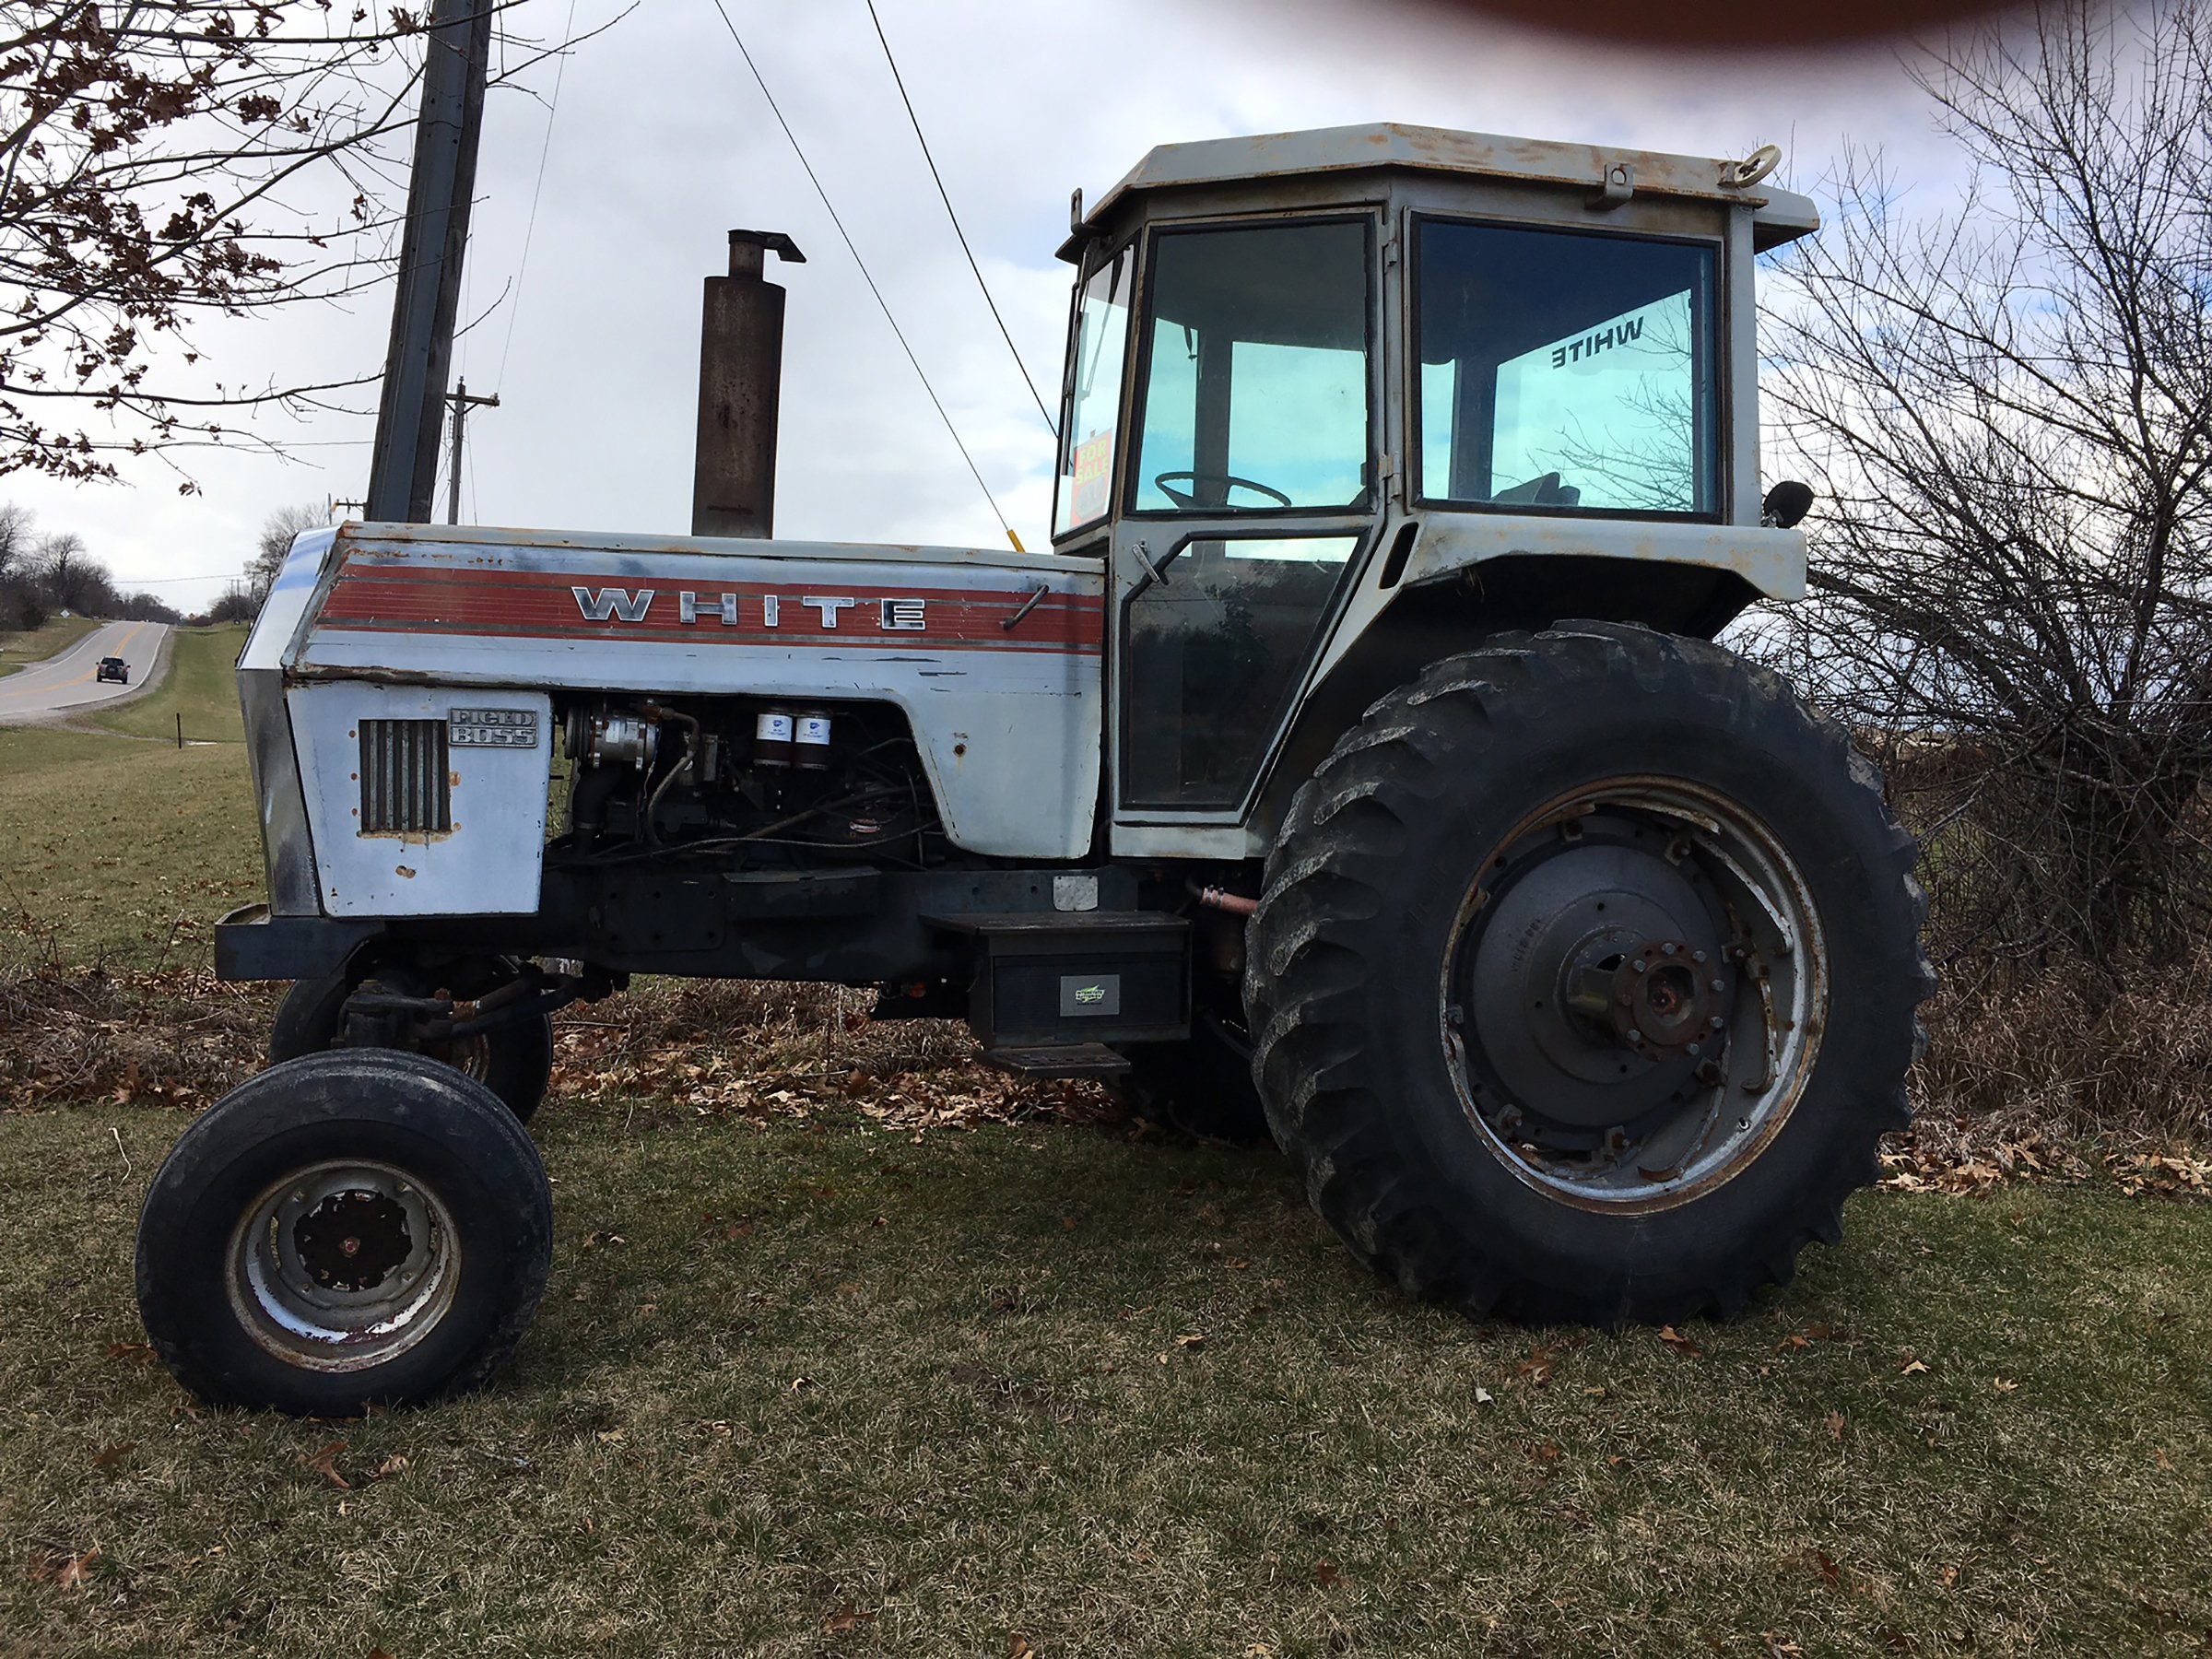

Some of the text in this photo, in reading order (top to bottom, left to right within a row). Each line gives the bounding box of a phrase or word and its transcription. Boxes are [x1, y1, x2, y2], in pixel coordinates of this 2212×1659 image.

[1079, 439, 1107, 465] FOR
[1076, 456, 1109, 486] SALE
[571, 586, 926, 630] WHITE
[452, 727, 535, 744] BOSS
